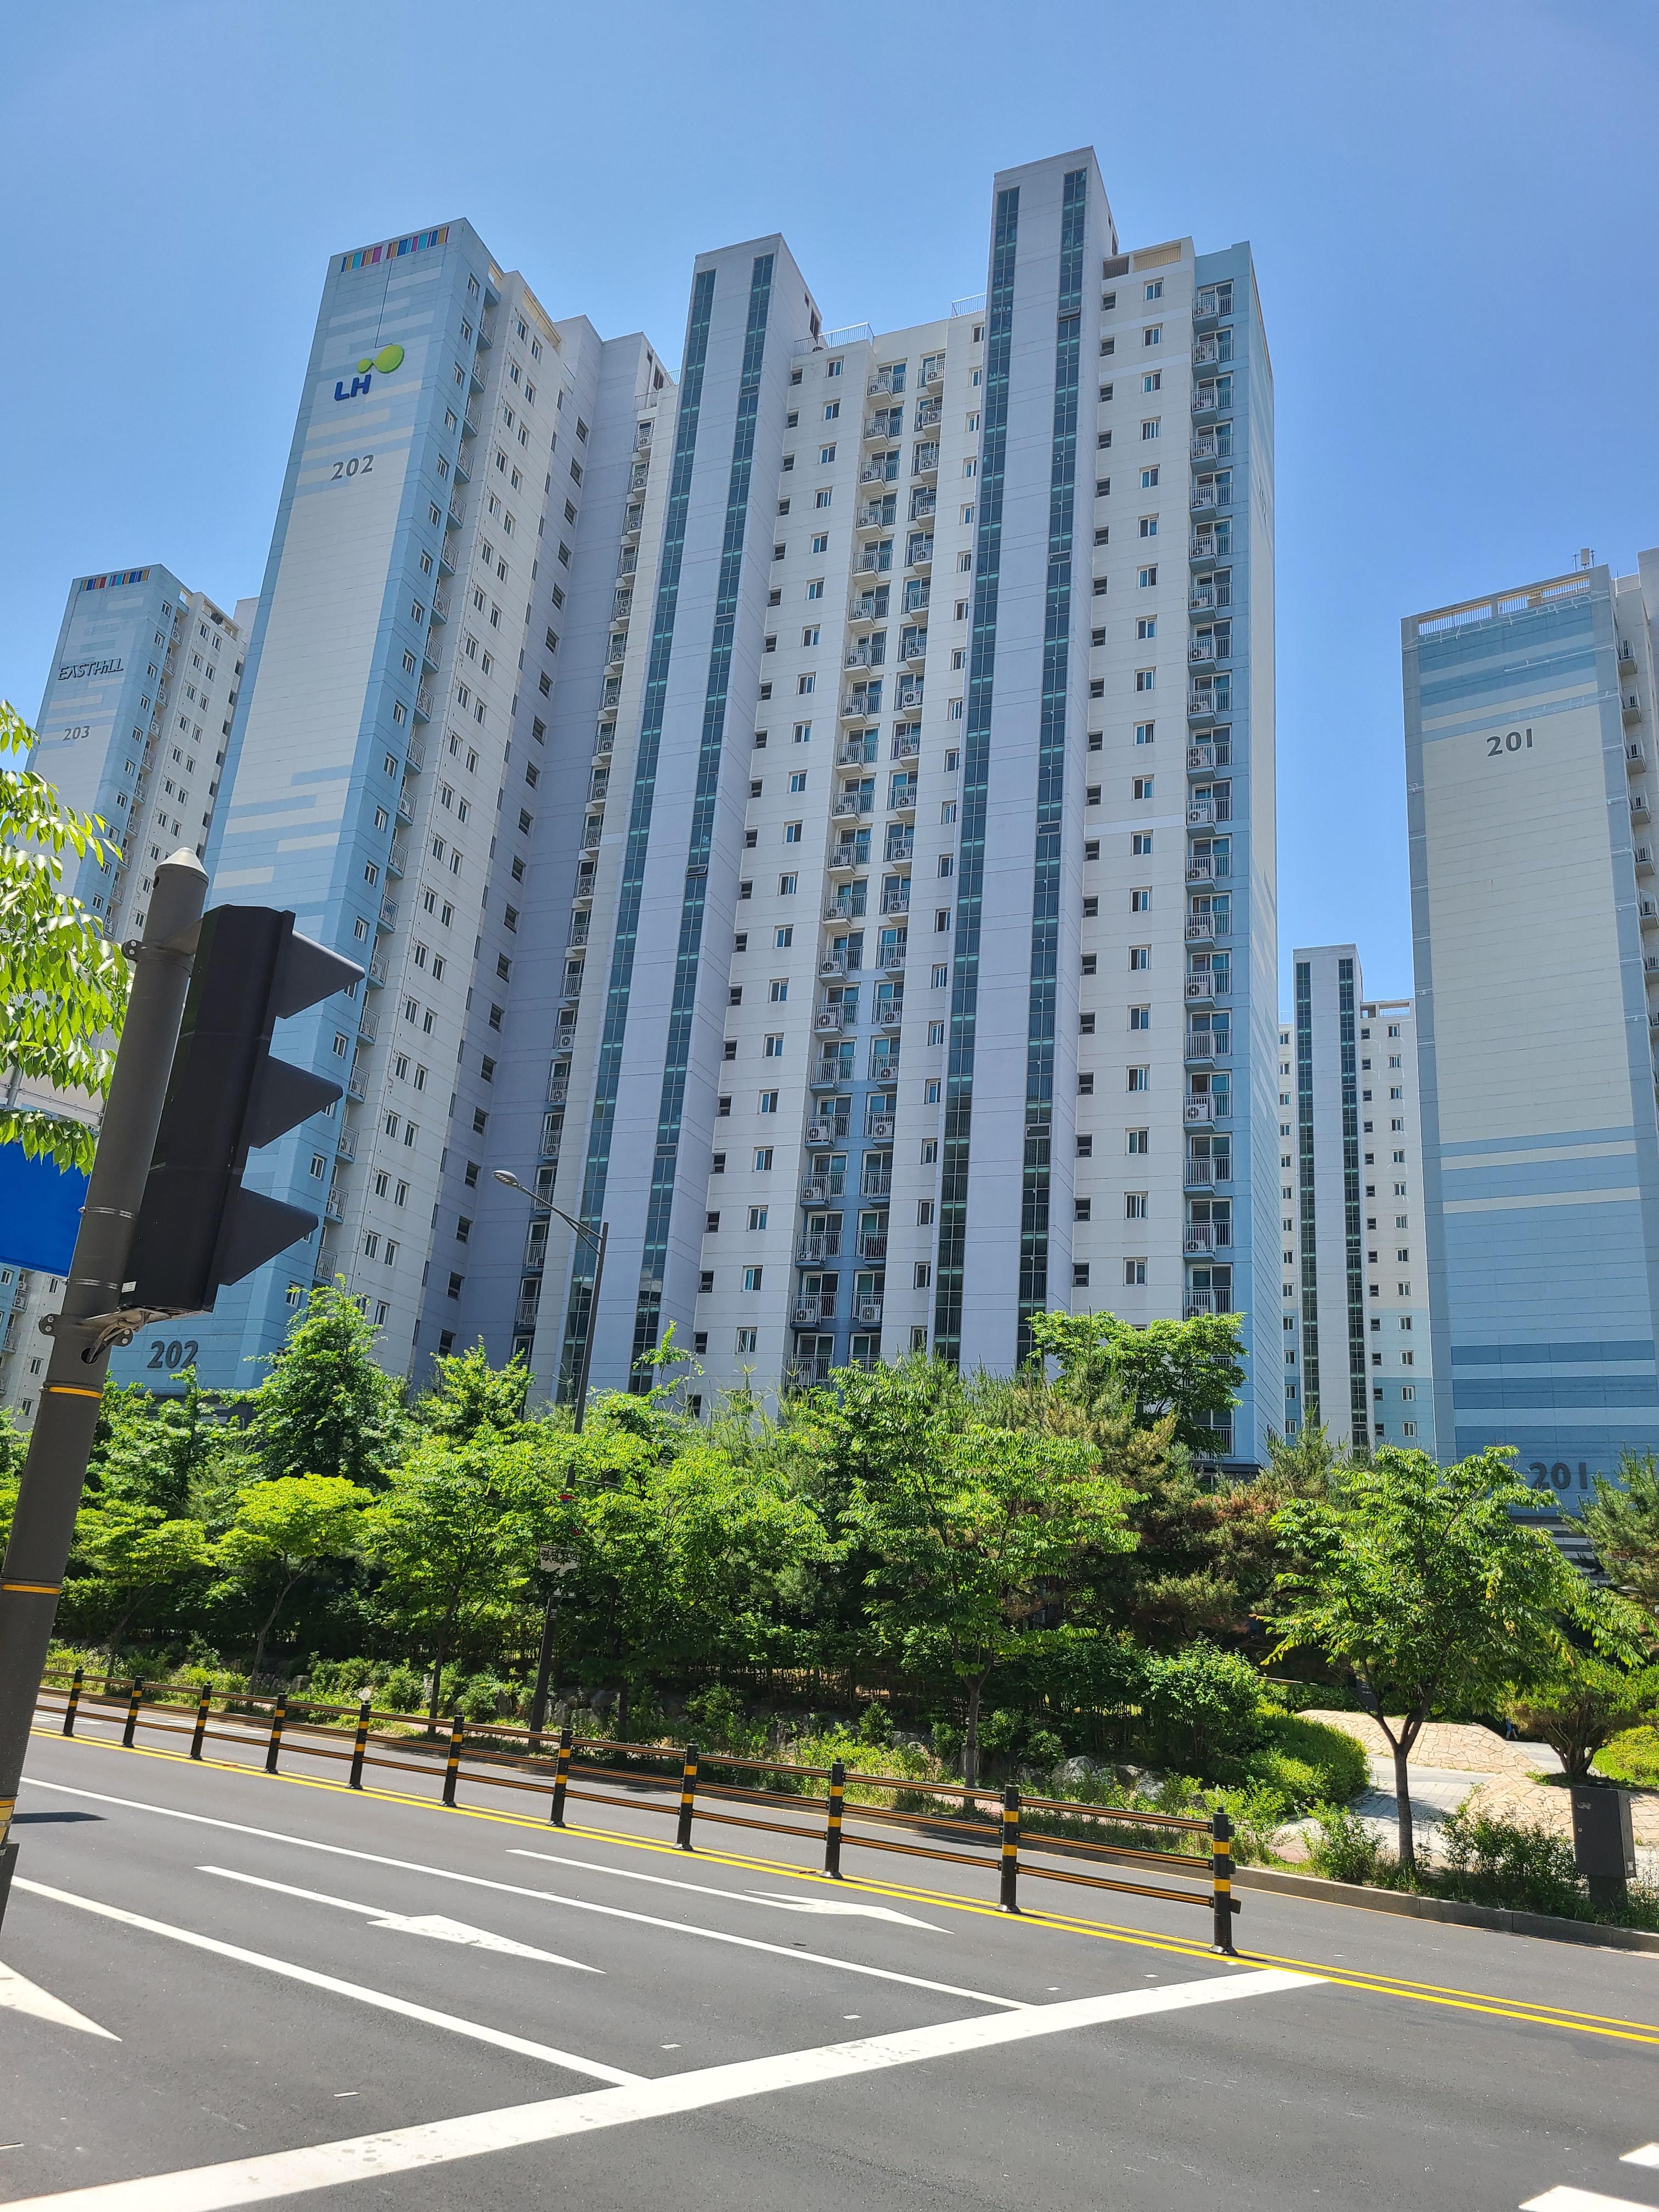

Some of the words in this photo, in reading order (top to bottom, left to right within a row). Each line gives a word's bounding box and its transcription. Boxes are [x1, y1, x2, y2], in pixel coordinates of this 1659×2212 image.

[334, 374, 372, 401] LH
[330, 454, 374, 481] 202
[63, 725, 90, 741] 203
[1486, 728, 1533, 757] 201
[147, 1340, 199, 1368] 202
[1530, 1462, 1588, 1489] 201
